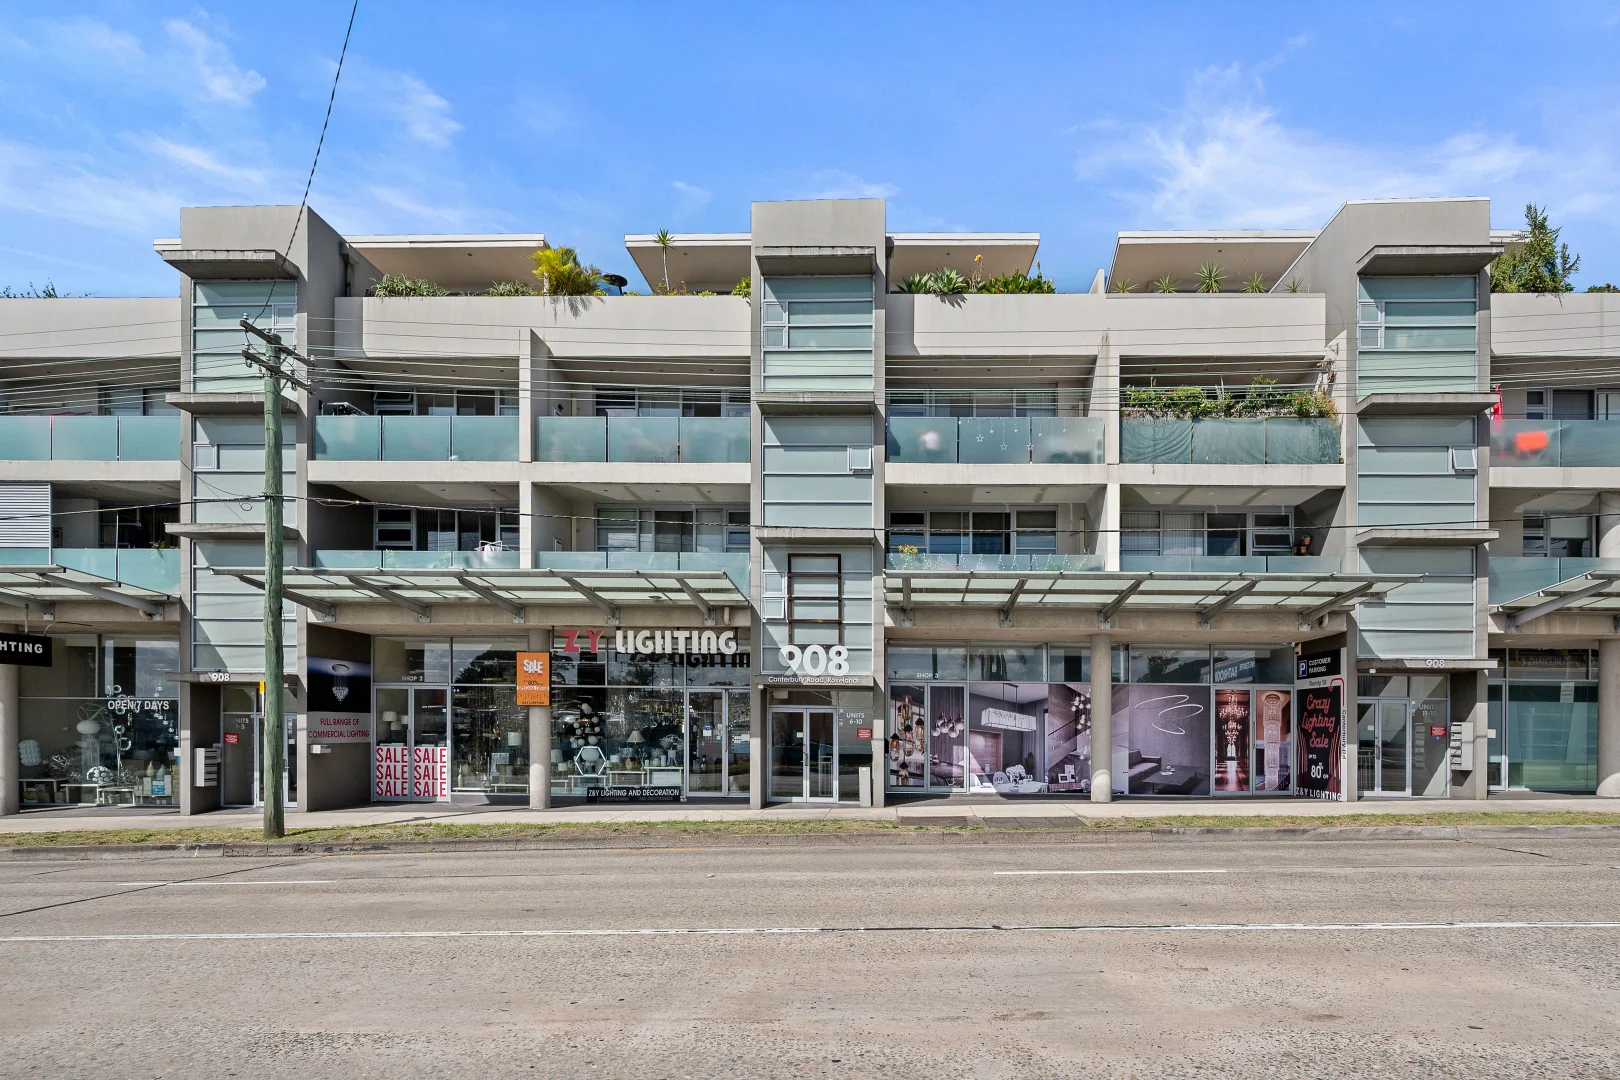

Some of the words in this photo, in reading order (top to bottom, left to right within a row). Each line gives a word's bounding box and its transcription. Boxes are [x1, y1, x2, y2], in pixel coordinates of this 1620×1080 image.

[0, 641, 43, 654] HTING
[616, 630, 737, 654] LIGHTING
[524, 659, 543, 674] SALE
[778, 644, 850, 676] 908
[1308, 657, 1332, 666] CUSTOMER
[1426, 660, 1444, 668] 908
[211, 673, 230, 681] 908
[108, 701, 133, 710] OPEN
[136, 701, 141, 710] 7
[144, 701, 169, 710] DAYS
[1306, 694, 1330, 714] Crazy
[1302, 712, 1335, 732] Lighting
[1310, 732, 1328, 748] Sale
[376, 748, 408, 763] SALE
[414, 748, 446, 763] SALE
[1342, 749, 1346, 759] Rd
[376, 764, 408, 780] SALE
[414, 765, 446, 780] SALE
[376, 781, 408, 796] SALE
[414, 782, 446, 797] SALE
[1296, 787, 1308, 796] Z&Y
[1310, 789, 1341, 801] LIGHTING
